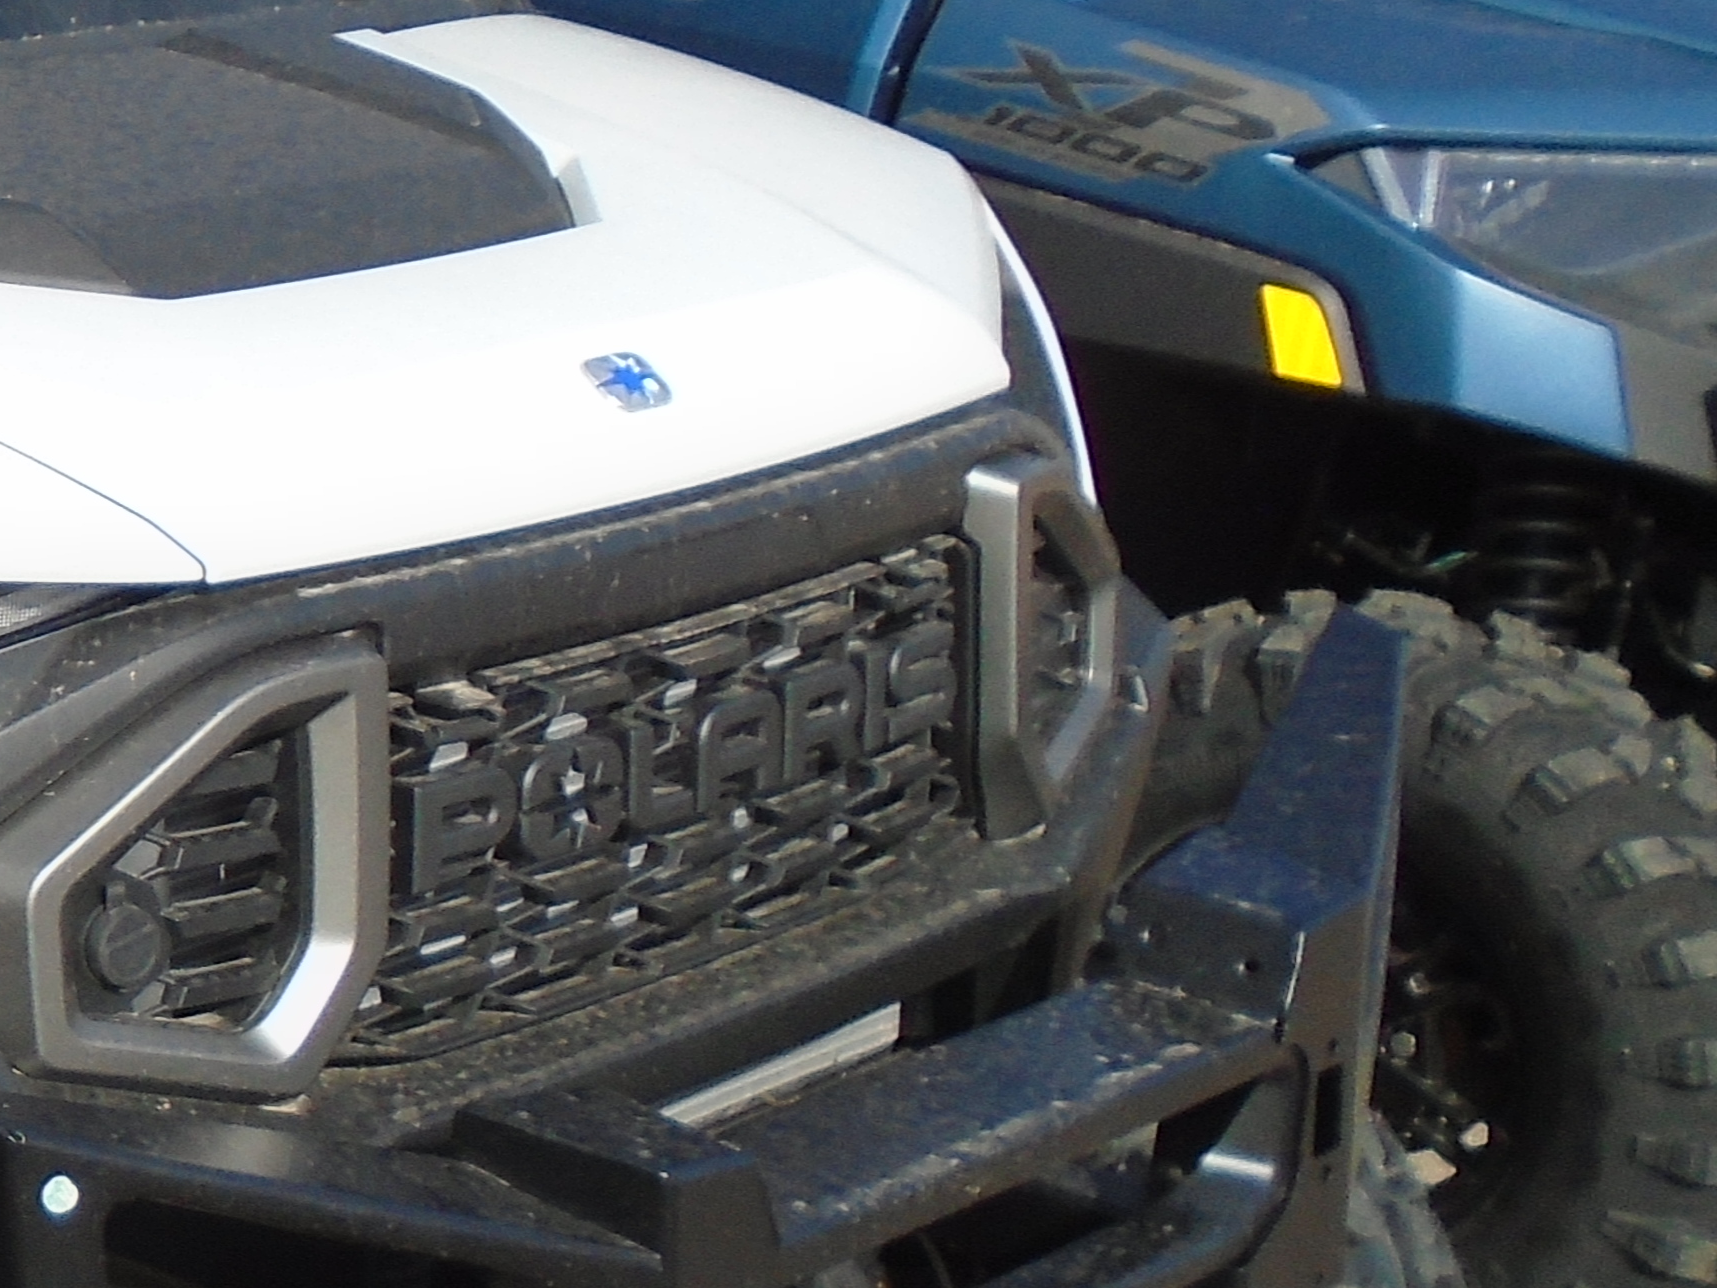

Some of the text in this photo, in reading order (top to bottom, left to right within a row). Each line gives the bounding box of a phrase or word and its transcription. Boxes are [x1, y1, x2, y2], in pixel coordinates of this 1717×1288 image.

[958, 39, 1278, 144] XP
[984, 106, 1211, 183] 1000
[395, 622, 958, 895] POLARIS
